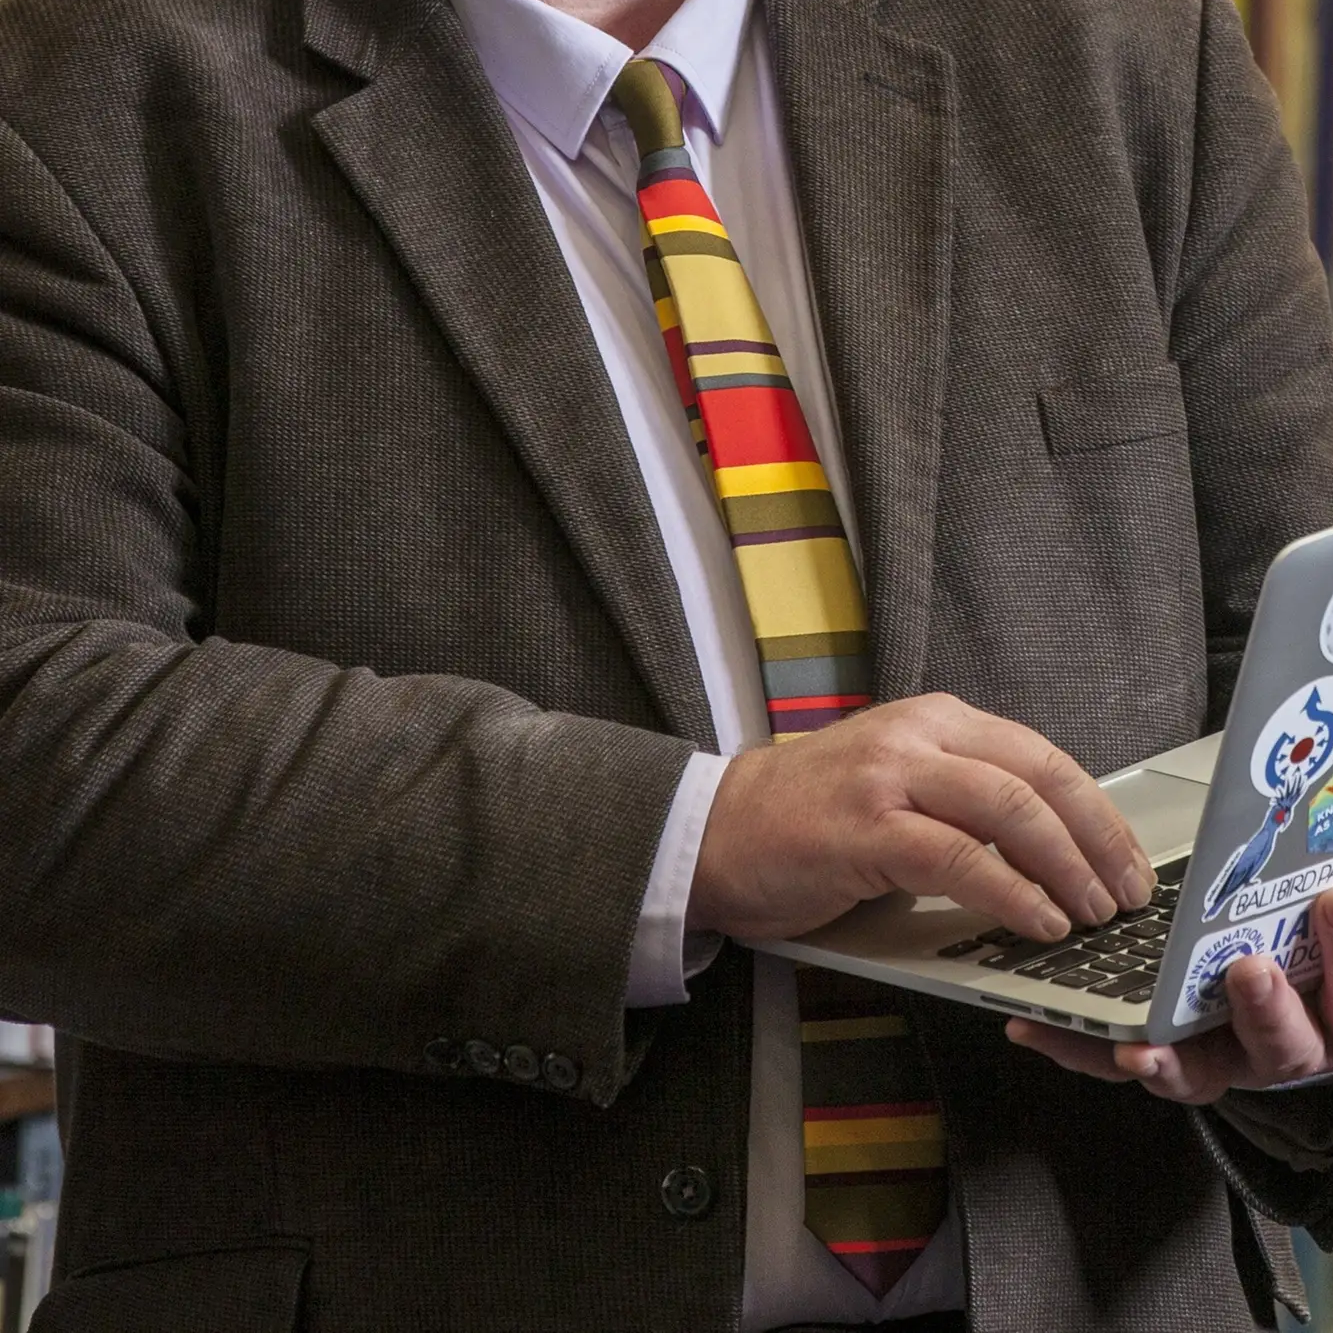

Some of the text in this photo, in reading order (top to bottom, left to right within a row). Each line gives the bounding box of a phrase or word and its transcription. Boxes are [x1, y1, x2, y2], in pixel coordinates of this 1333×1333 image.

[1314, 820, 1330, 837] AS
[1235, 889, 1276, 916] BALI
[1276, 870, 1316, 902] BIRD
